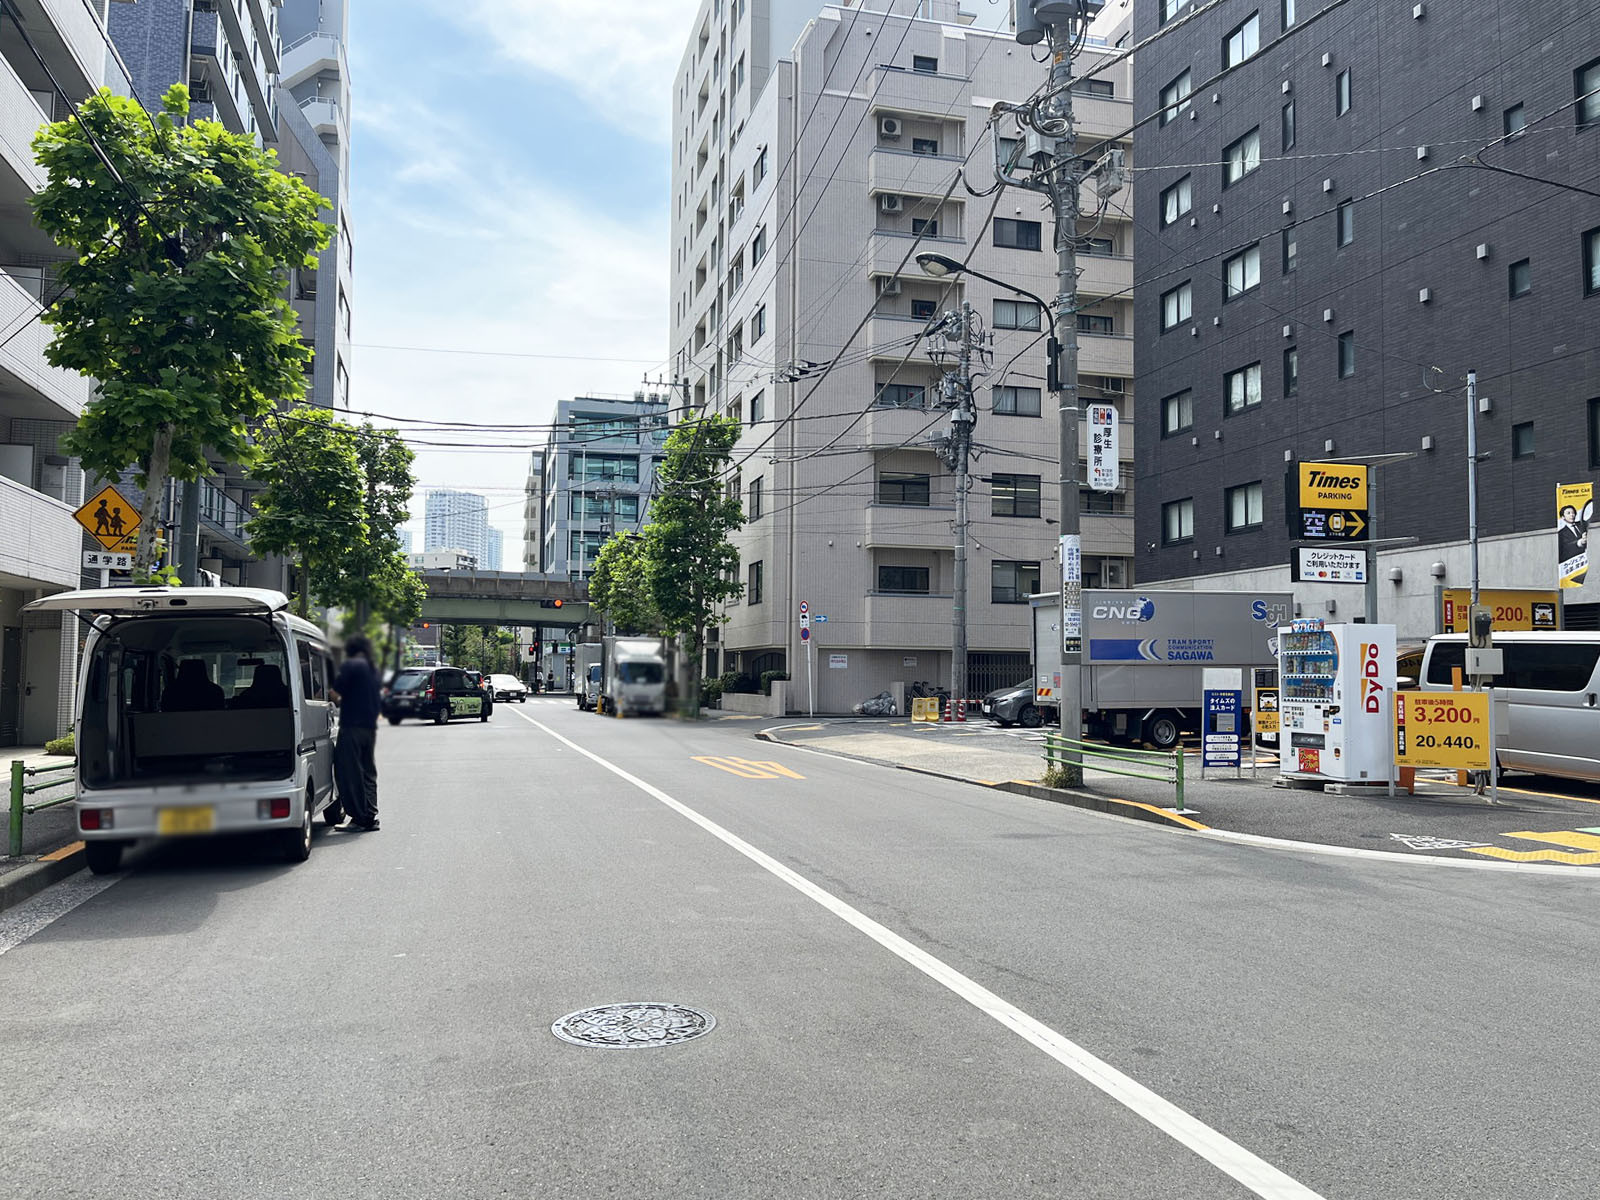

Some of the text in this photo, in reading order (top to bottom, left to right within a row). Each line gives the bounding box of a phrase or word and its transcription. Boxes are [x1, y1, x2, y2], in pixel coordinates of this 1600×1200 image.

[1103, 428, 1112, 449] 厚生
[1094, 433, 1102, 466] 診療所
[1308, 471, 1360, 489] Times
[1318, 492, 1352, 500] PARKING
[1304, 511, 1326, 537] 空
[87, 554, 127, 567] 通学路
[1311, 552, 1355, 560] クレジットカード
[1306, 560, 1360, 569] ご利用いただけます
[1093, 606, 1141, 619] CNG
[1491, 607, 1529, 623] ,200円
[1168, 651, 1214, 660] SAGAWA
[1366, 643, 1383, 713] DyDo
